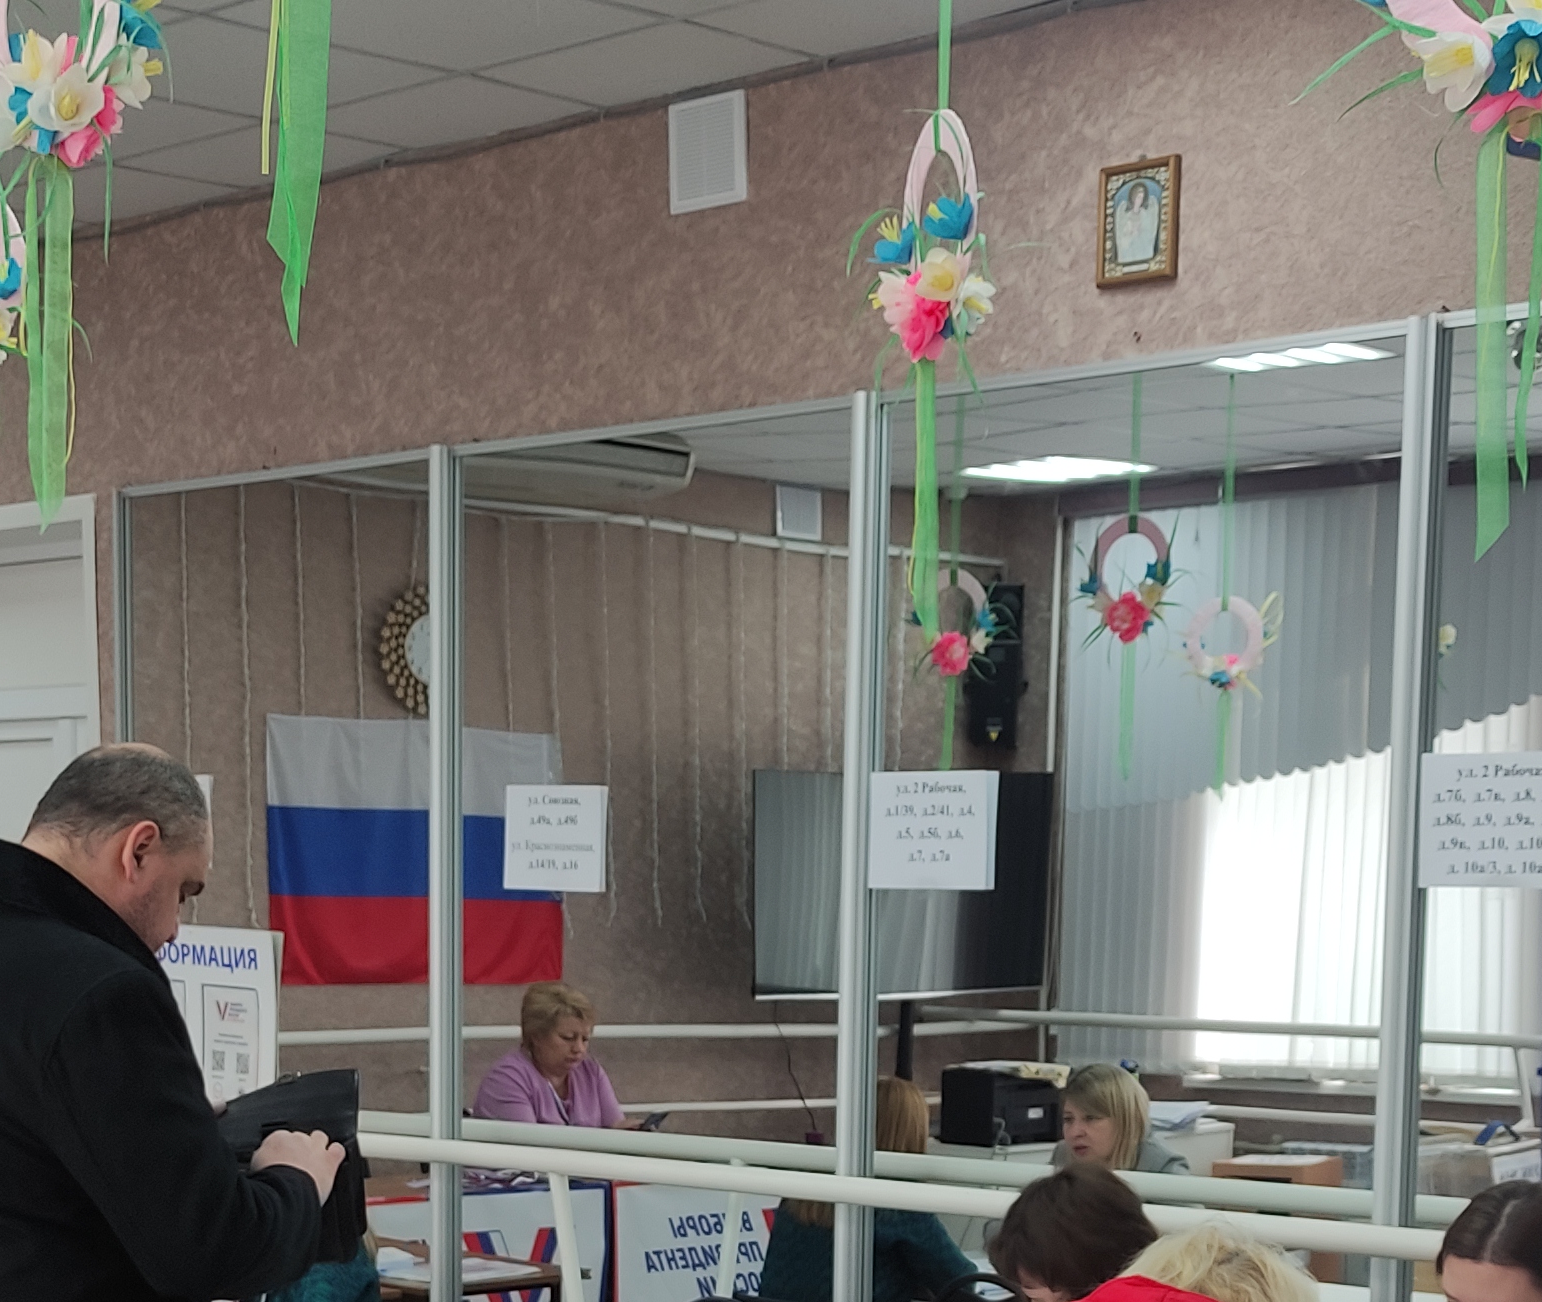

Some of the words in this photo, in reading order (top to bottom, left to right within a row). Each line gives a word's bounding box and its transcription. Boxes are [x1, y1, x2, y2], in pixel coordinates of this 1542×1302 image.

[1482, 765, 1489, 777] 2
[914, 781, 918, 793] 2
[159, 943, 258, 973] ОРМАЦИЯ
